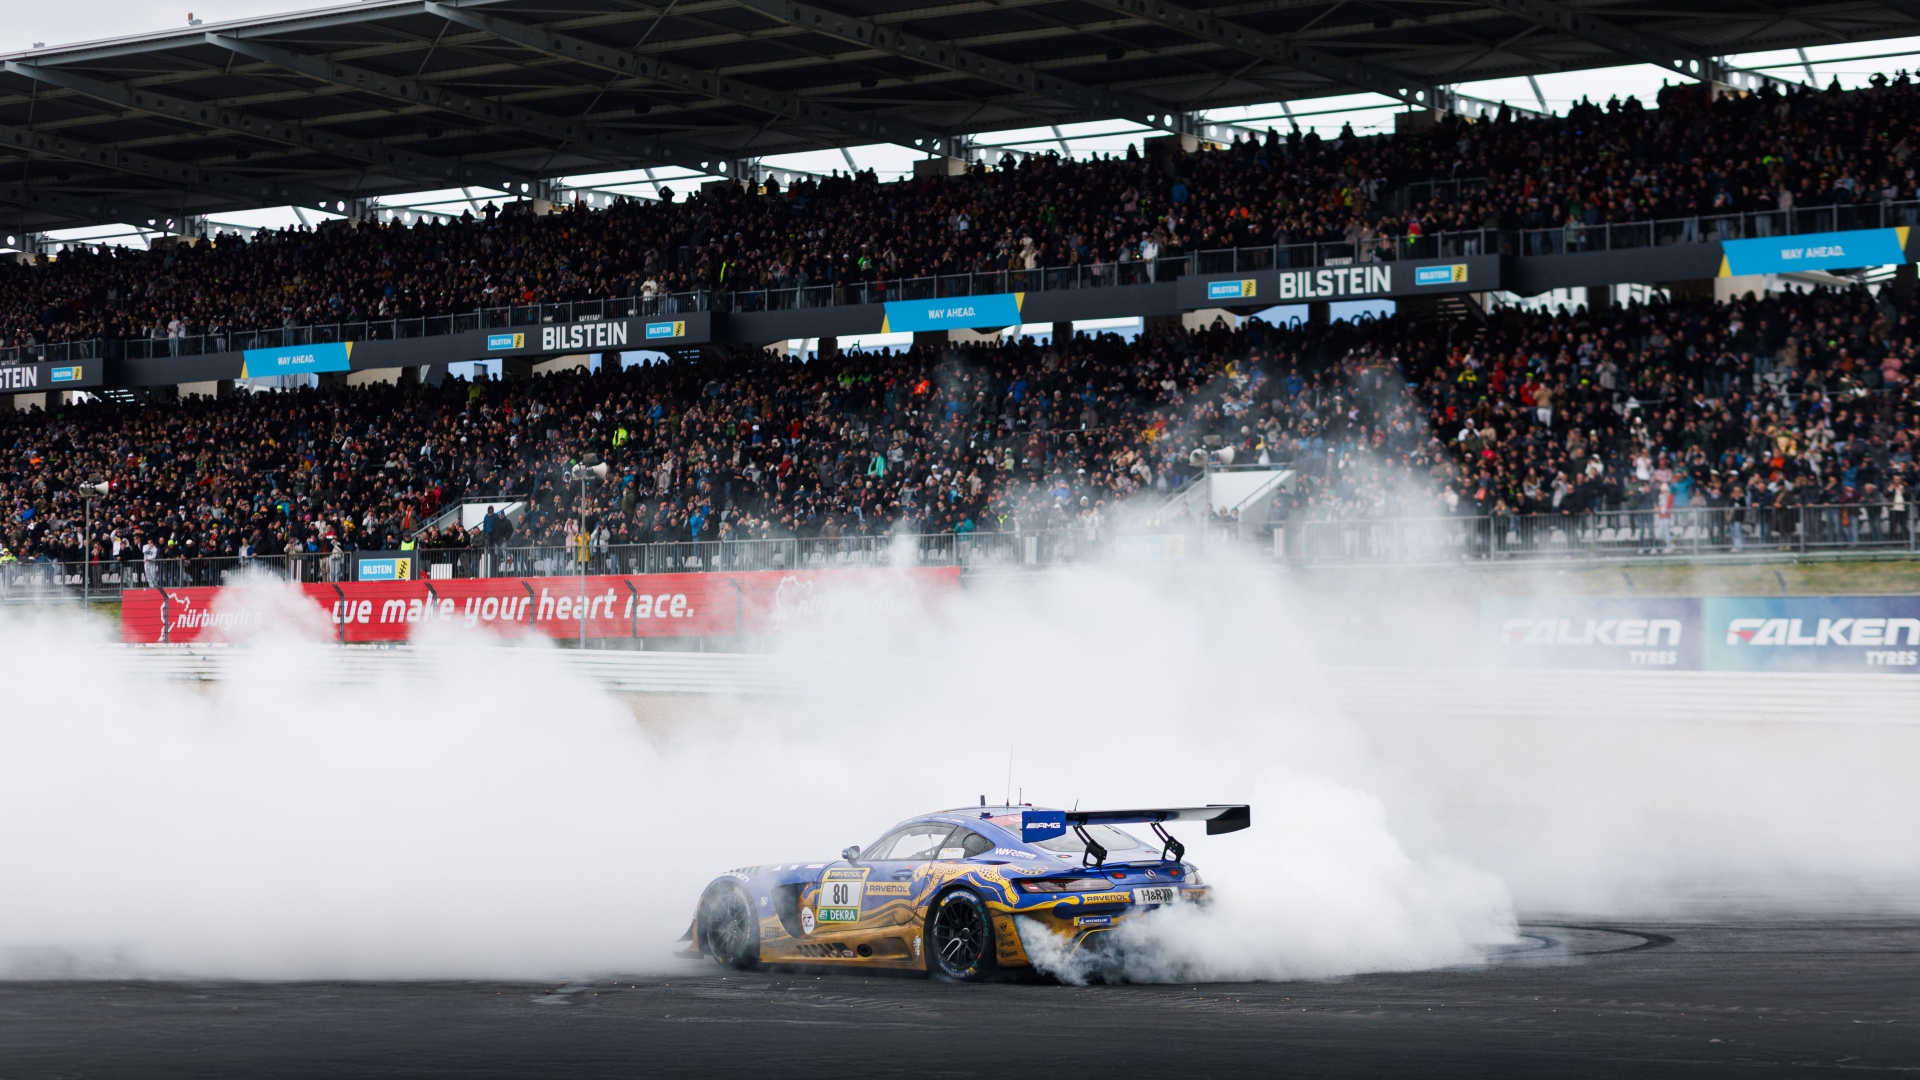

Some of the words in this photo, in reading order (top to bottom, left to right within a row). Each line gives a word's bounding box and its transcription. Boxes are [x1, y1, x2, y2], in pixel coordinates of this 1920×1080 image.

[1781, 249, 1803, 260] WAY
[1805, 245, 1845, 258] AHEAD.
[1279, 265, 1391, 299] BILSTEIN
[928, 309, 944, 319] WAY
[946, 307, 976, 318] AHEAD.
[542, 321, 628, 350] BILSTEIN
[649, 325, 671, 335] BILSTEIN
[490, 337, 512, 346] BILSTEIN
[277, 356, 291, 365] WAY
[291, 354, 315, 364] AHEAD.
[363, 565, 392, 575] BILSTEIN
[332, 599, 371, 624] we
[381, 590, 453, 624] make
[464, 597, 531, 629] your
[536, 587, 617, 620] heart
[624, 592, 694, 618] race.
[1502, 618, 1682, 646] FALKEN
[1726, 617, 1920, 646] FALKEN
[1629, 650, 1678, 666] TYRES
[1866, 650, 1918, 666] TYRES
[833, 883, 848, 905] 80
[1086, 894, 1126, 902] RAVENOL
[1142, 889, 1163, 902] H&R
[830, 910, 855, 920] DEKRA
